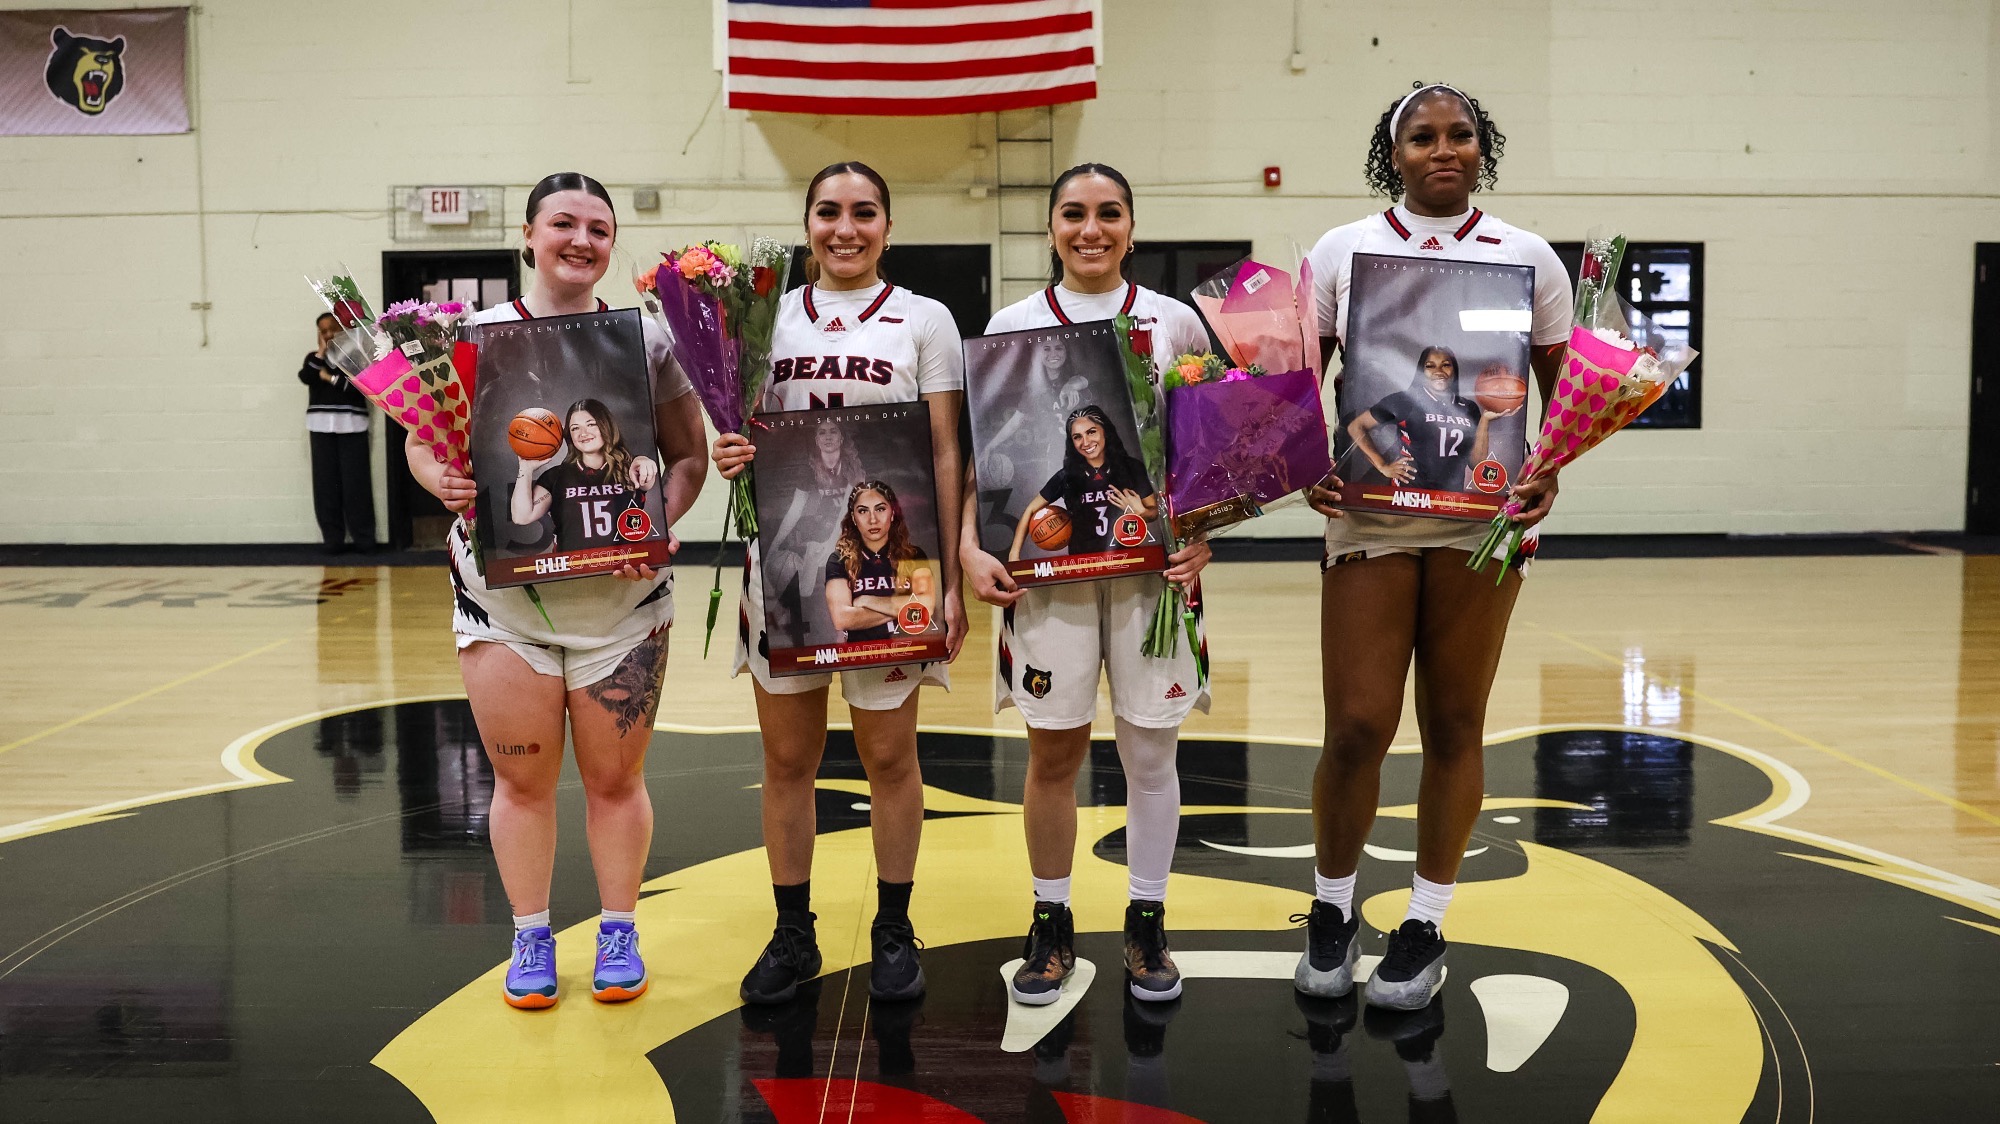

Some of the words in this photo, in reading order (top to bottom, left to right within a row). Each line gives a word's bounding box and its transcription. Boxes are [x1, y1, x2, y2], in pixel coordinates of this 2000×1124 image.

[431, 191, 460, 213] EXIT
[1373, 262, 1407, 271] 2026
[1420, 267, 1474, 276] SENIOR
[1487, 271, 1513, 279] DAY
[480, 329, 514, 339] 2026
[527, 322, 581, 334] SENIOR
[594, 318, 620, 327] DAY
[982, 340, 1016, 350] 2026
[1027, 332, 1080, 344] SENIOR
[773, 355, 894, 386] BEARS
[771, 419, 804, 428] 2026
[817, 414, 870, 424] SENIOR
[882, 411, 907, 419] DAY
[1425, 413, 1471, 427] BEARS
[1438, 426, 1464, 458] 12
[565, 483, 624, 499] BEARS
[1391, 490, 1432, 509] ANISHA
[579, 500, 613, 539] 15
[1208, 504, 1234, 517] CRISPY
[1094, 505, 1109, 537] 3
[535, 555, 571, 575] CHLOE
[1034, 561, 1055, 578] MIA
[814, 647, 840, 665] ANIA
